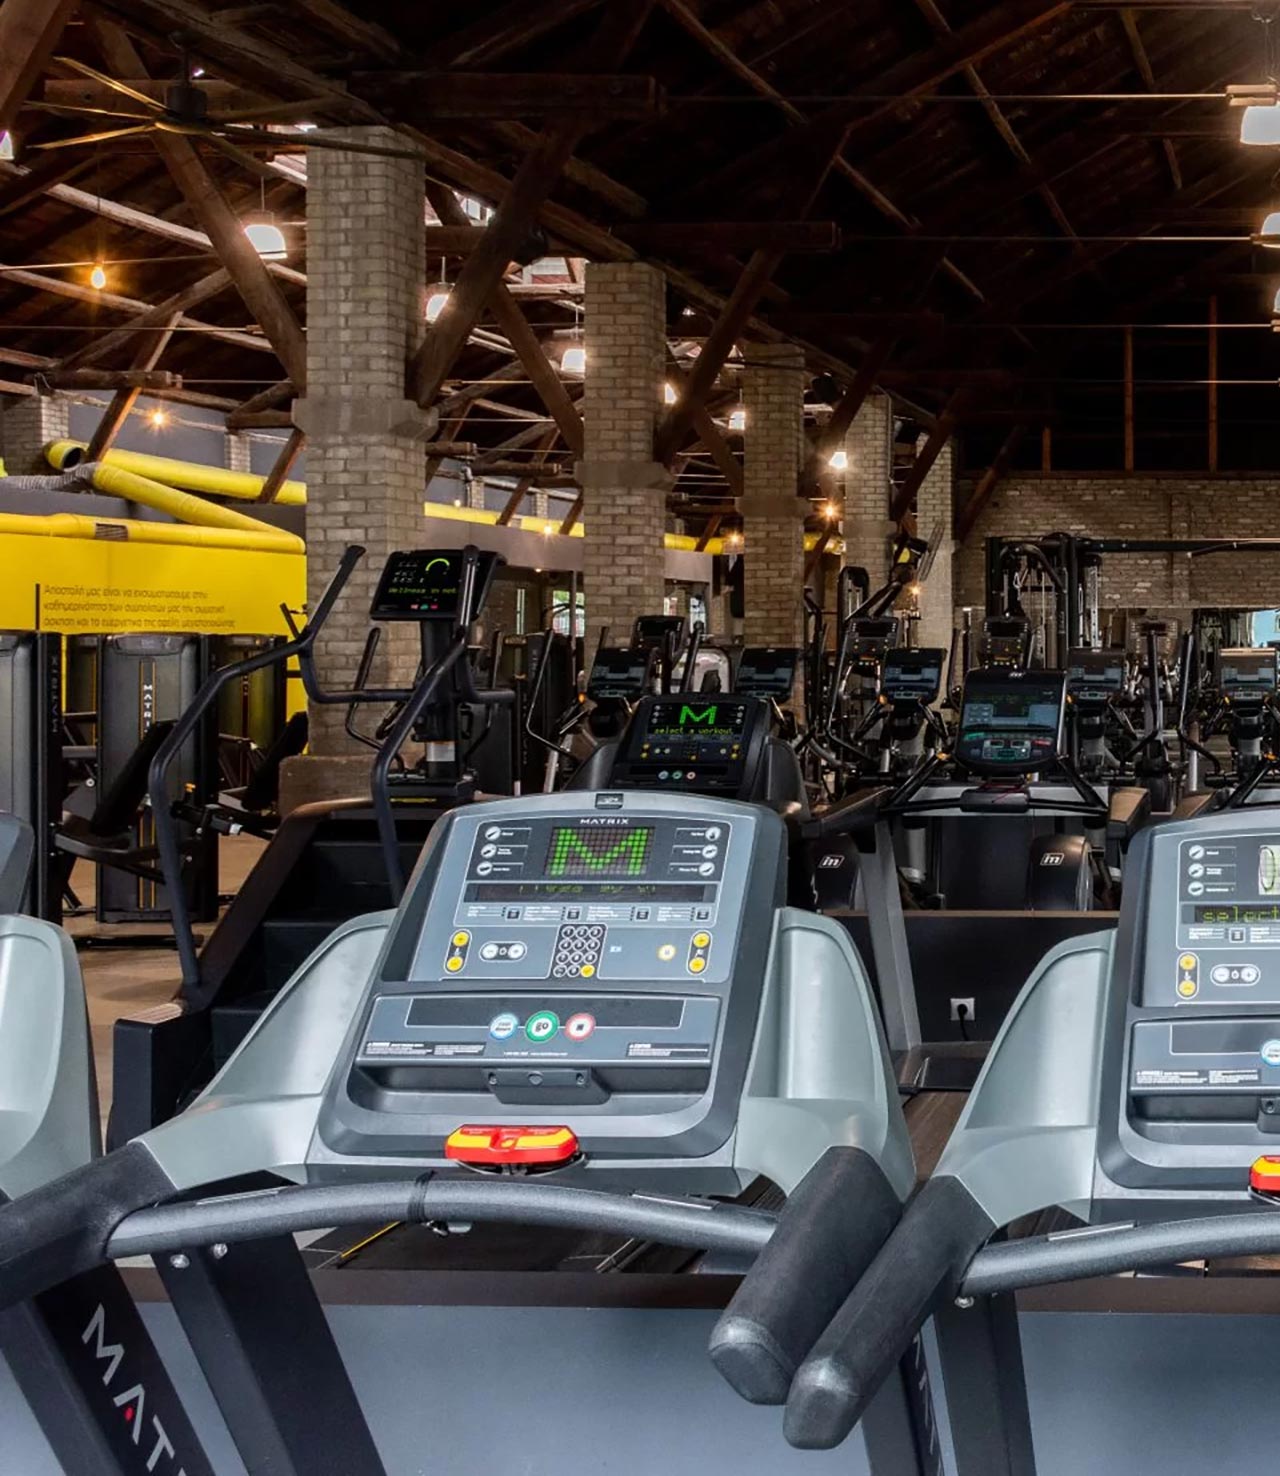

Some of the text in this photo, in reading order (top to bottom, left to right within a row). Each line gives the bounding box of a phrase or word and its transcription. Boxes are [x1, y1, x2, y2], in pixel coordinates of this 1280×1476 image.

[143, 683, 154, 734] MATRI
[1202, 906, 1280, 922] select
[81, 1303, 187, 1476] MAT
